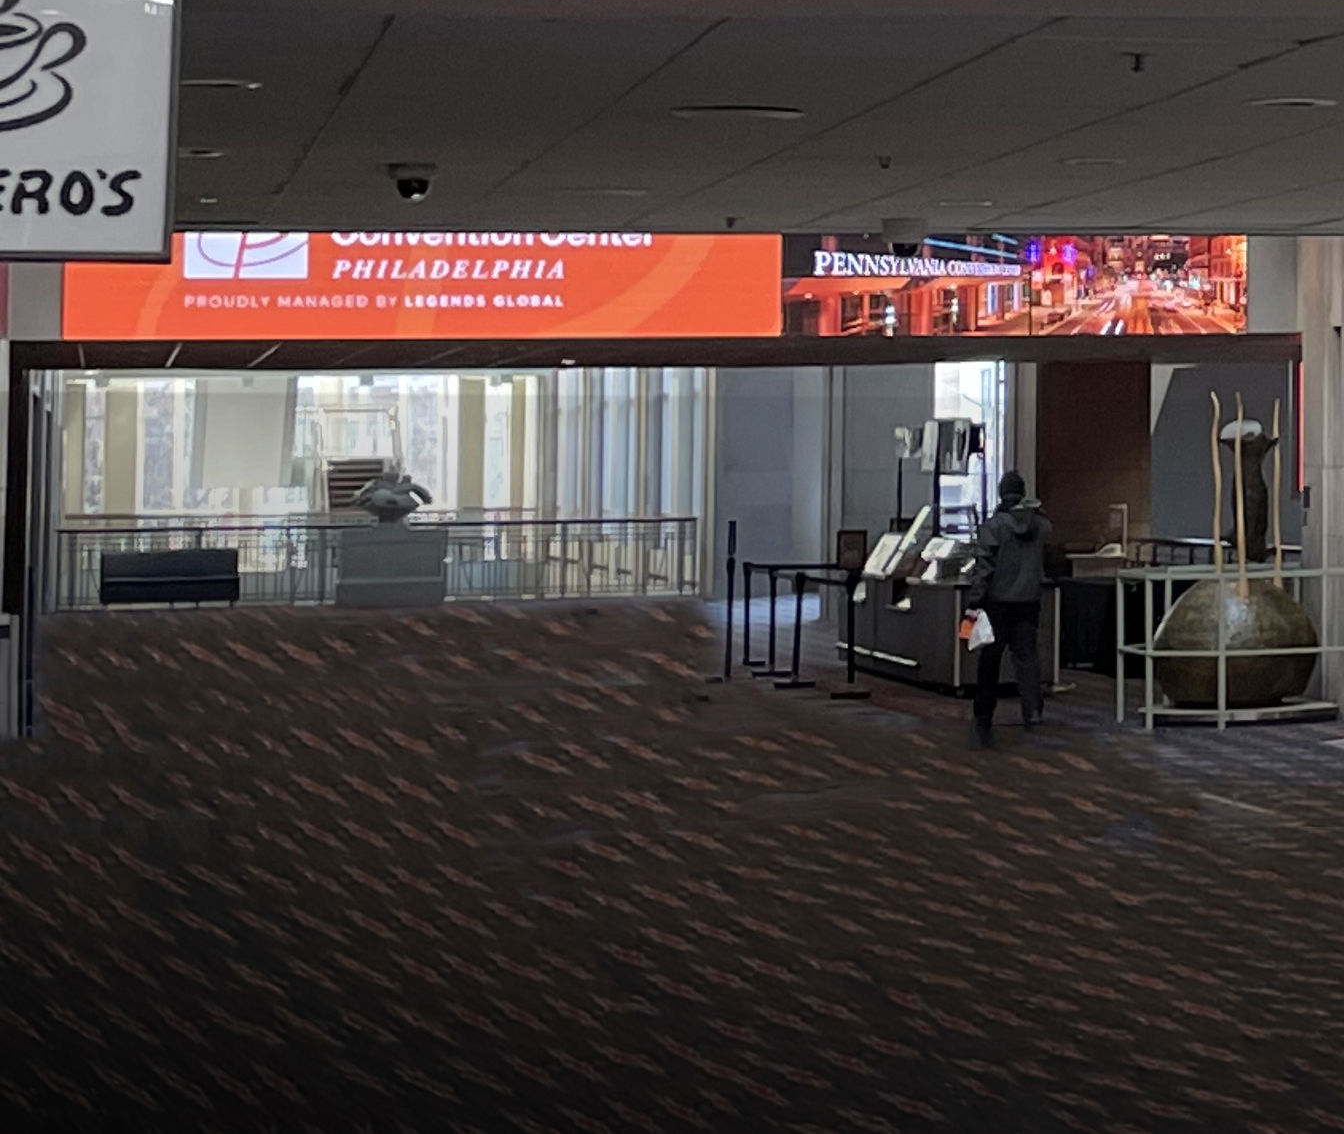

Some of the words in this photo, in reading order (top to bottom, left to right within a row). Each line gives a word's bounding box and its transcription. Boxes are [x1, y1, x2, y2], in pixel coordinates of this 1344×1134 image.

[332, 258, 565, 280] PHILADELPHIA
[813, 251, 947, 276] PENNSYLVANIA
[184, 294, 270, 309] PROUDLY
[277, 294, 369, 309] MANAGED
[403, 293, 487, 309] LEGENDS
[492, 293, 564, 309] GLOBAL
